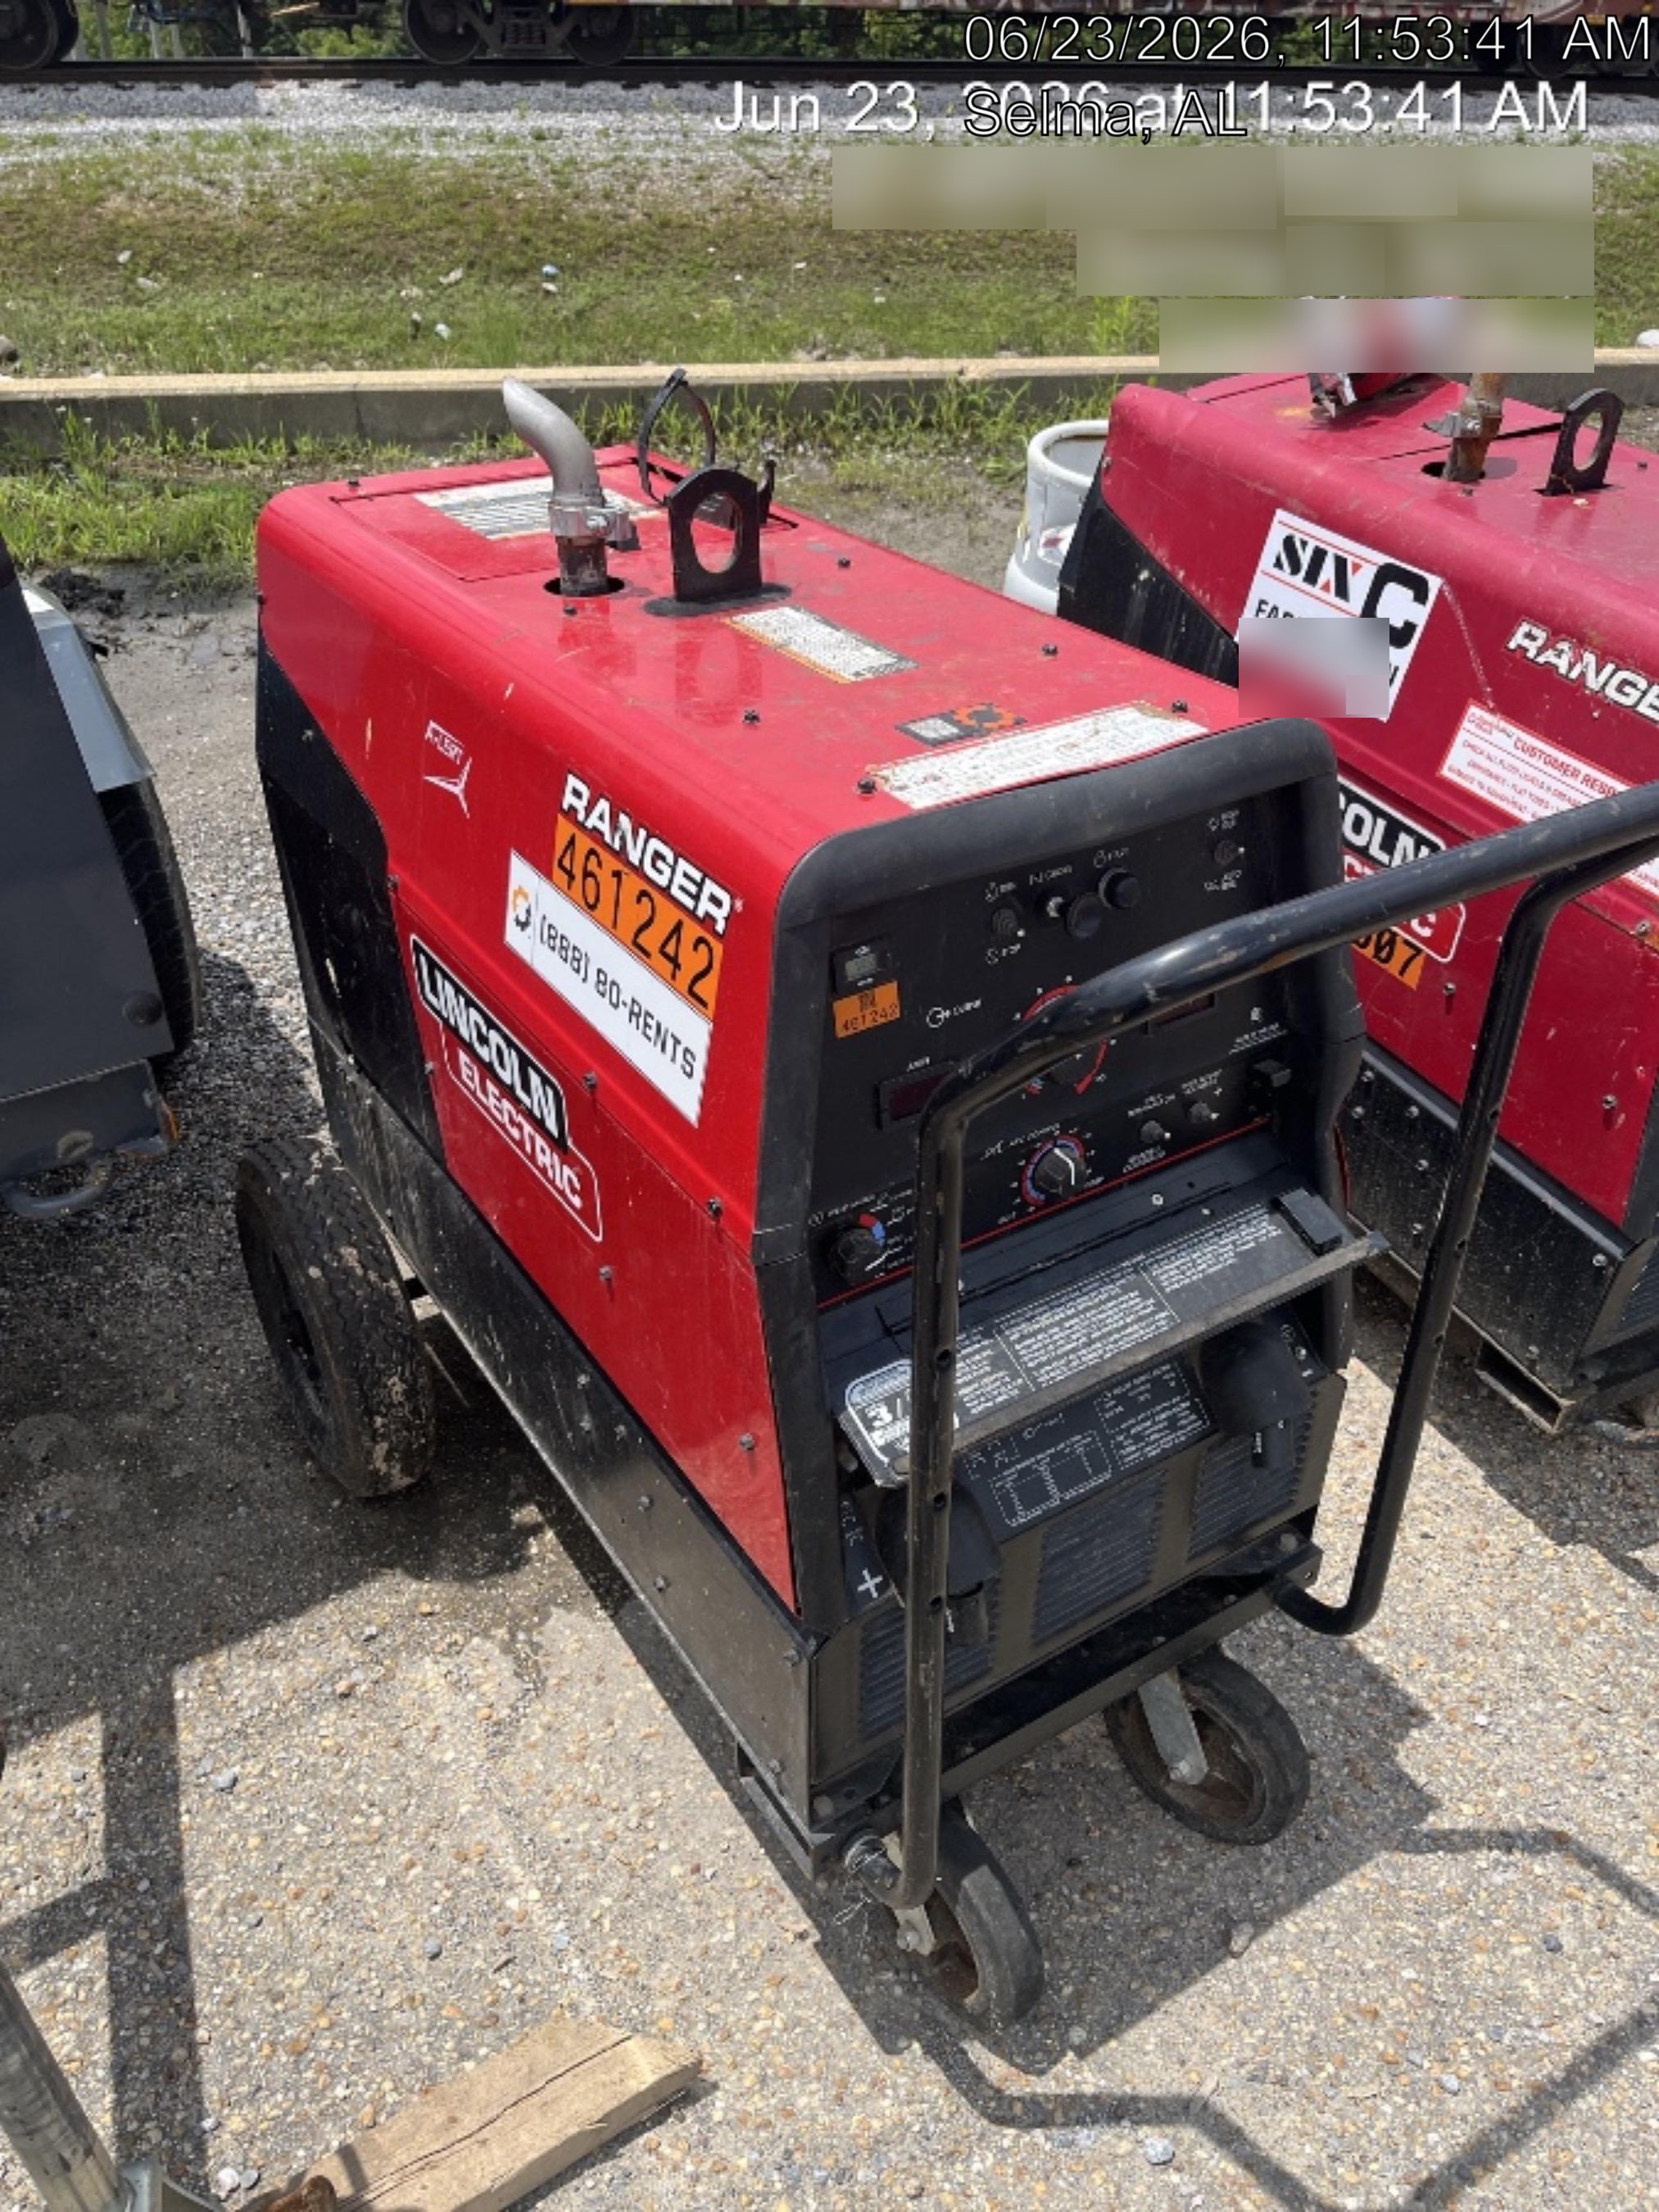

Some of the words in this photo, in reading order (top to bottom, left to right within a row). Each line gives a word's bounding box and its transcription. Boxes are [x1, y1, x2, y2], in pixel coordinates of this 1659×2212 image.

[1272, 533, 1363, 603] SIX
[1360, 562, 1429, 649] C
[1514, 736, 1581, 781] CUSTOMER
[556, 832, 715, 1010] 461242
[561, 770, 735, 937] RANGER
[419, 952, 560, 1140] LINCOLN
[539, 914, 591, 985] (888)
[596, 968, 697, 1080] 80-RENTS
[457, 1048, 584, 1211] ELECTRIC
